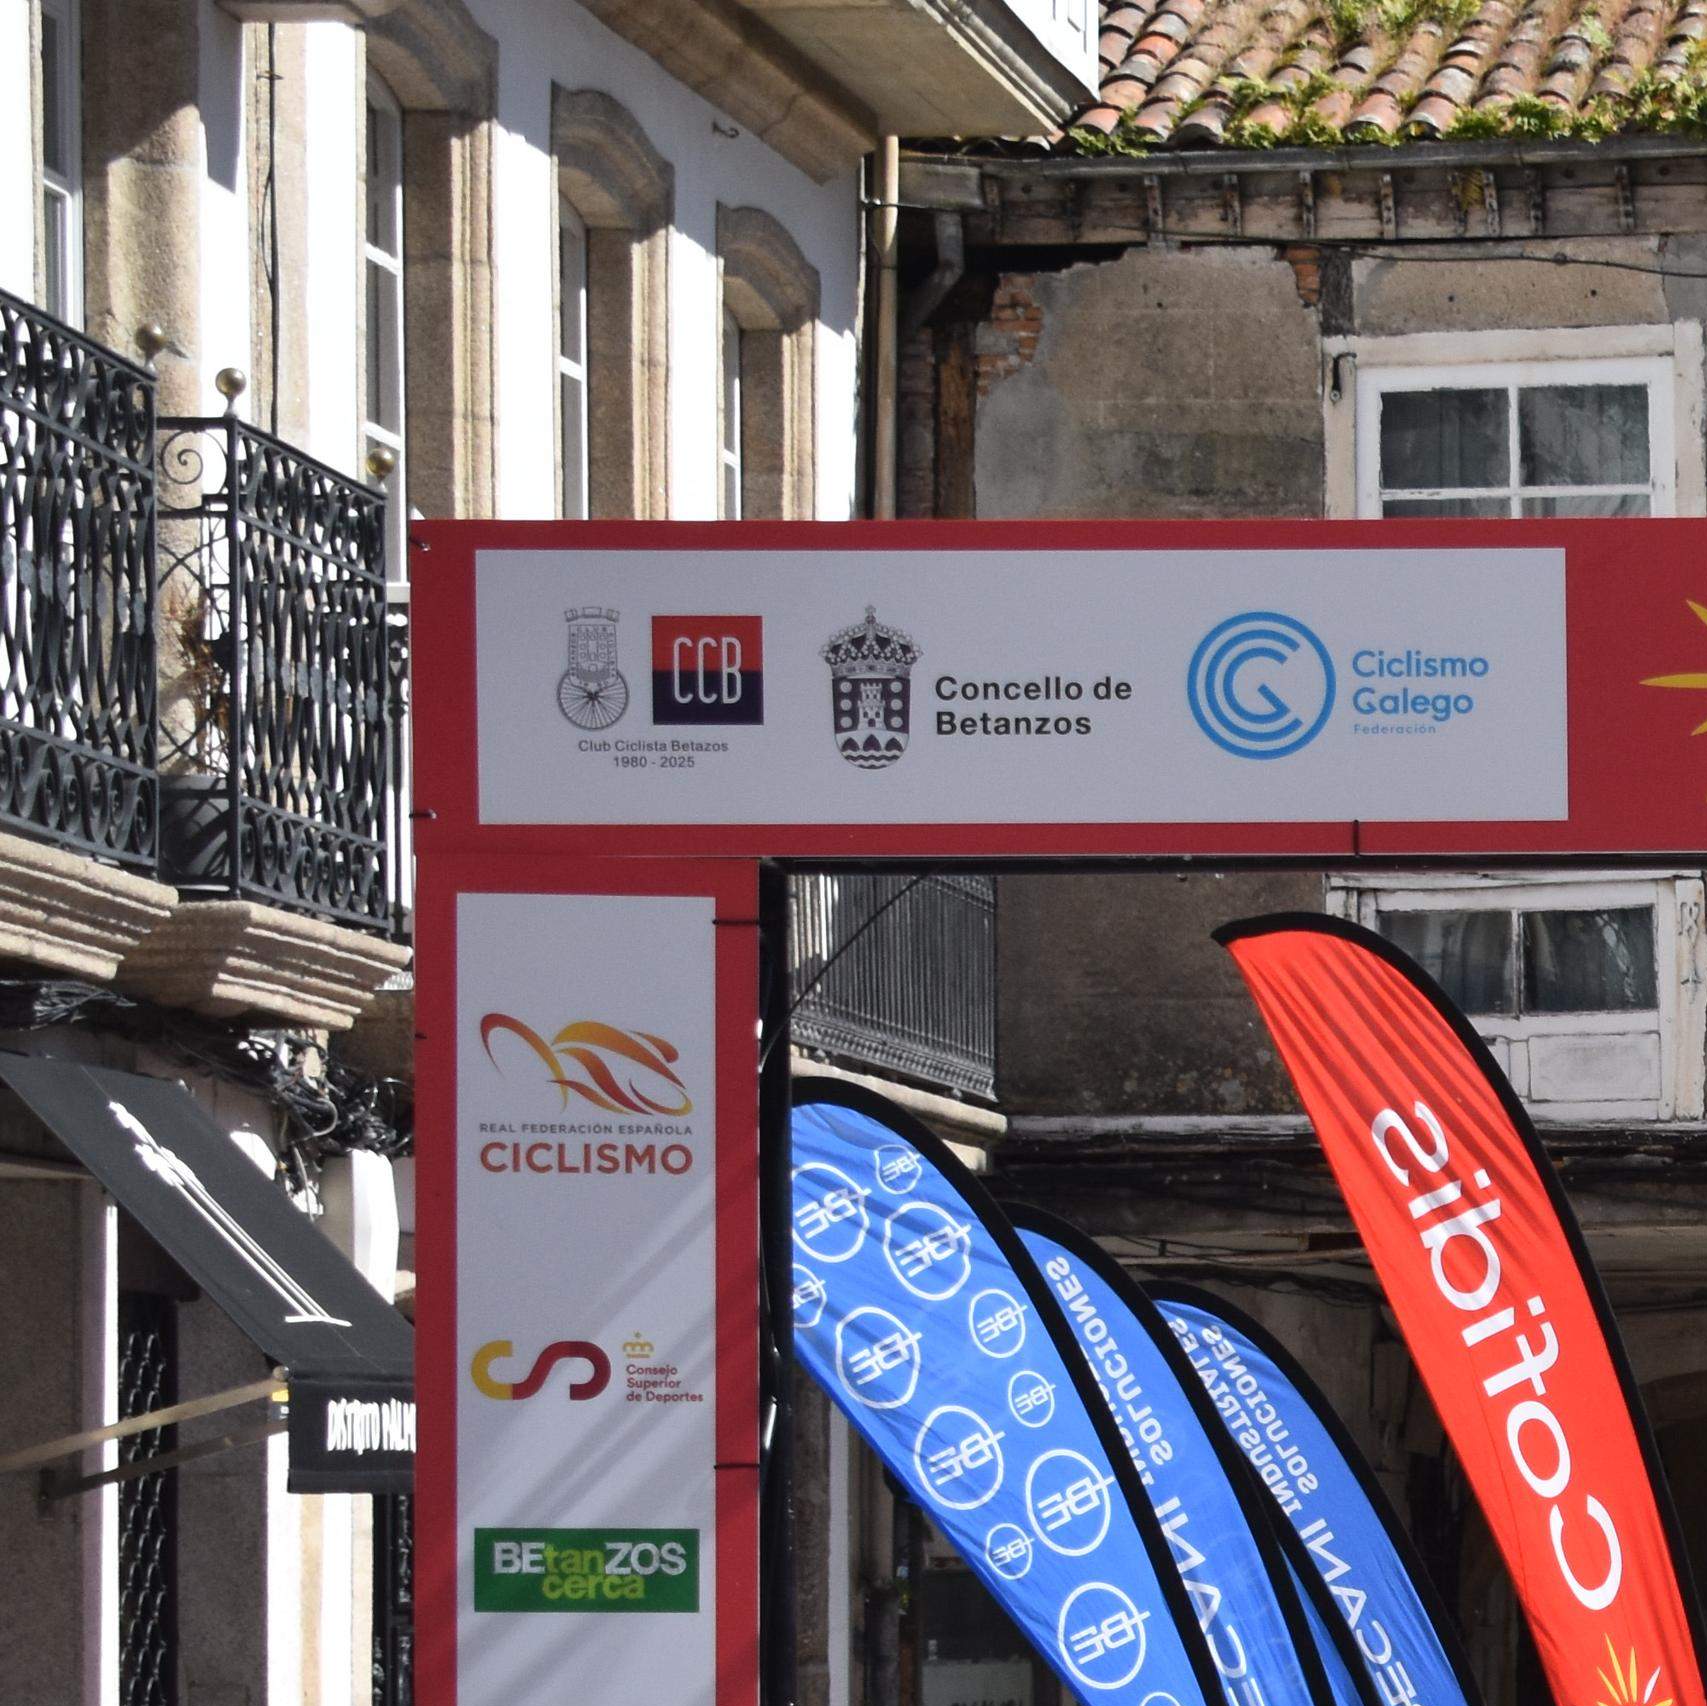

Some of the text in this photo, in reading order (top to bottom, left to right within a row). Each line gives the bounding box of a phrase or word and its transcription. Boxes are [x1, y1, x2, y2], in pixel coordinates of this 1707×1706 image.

[673, 636, 742, 705] CCB
[1352, 650, 1489, 678] Ciclismo
[935, 675, 1132, 702] Concello de
[1352, 687, 1474, 722] Galego
[936, 711, 1092, 737] Betanzos
[1353, 722, 1436, 735] Federación
[578, 740, 729, 752] Club Ciclista Betazos
[613, 756, 647, 768] 1980
[659, 756, 695, 768] 2025
[479, 1122, 693, 1135] REAL FEDERACIÓN ESPAÑOLA
[480, 1142, 693, 1175] CICLISMO
[626, 1364, 678, 1380] Consejo
[626, 1377, 682, 1390] Superior
[626, 1390, 704, 1403] de Deportes
[493, 1541, 687, 1576] BEtanZOS
[542, 1573, 645, 1600] cerca
